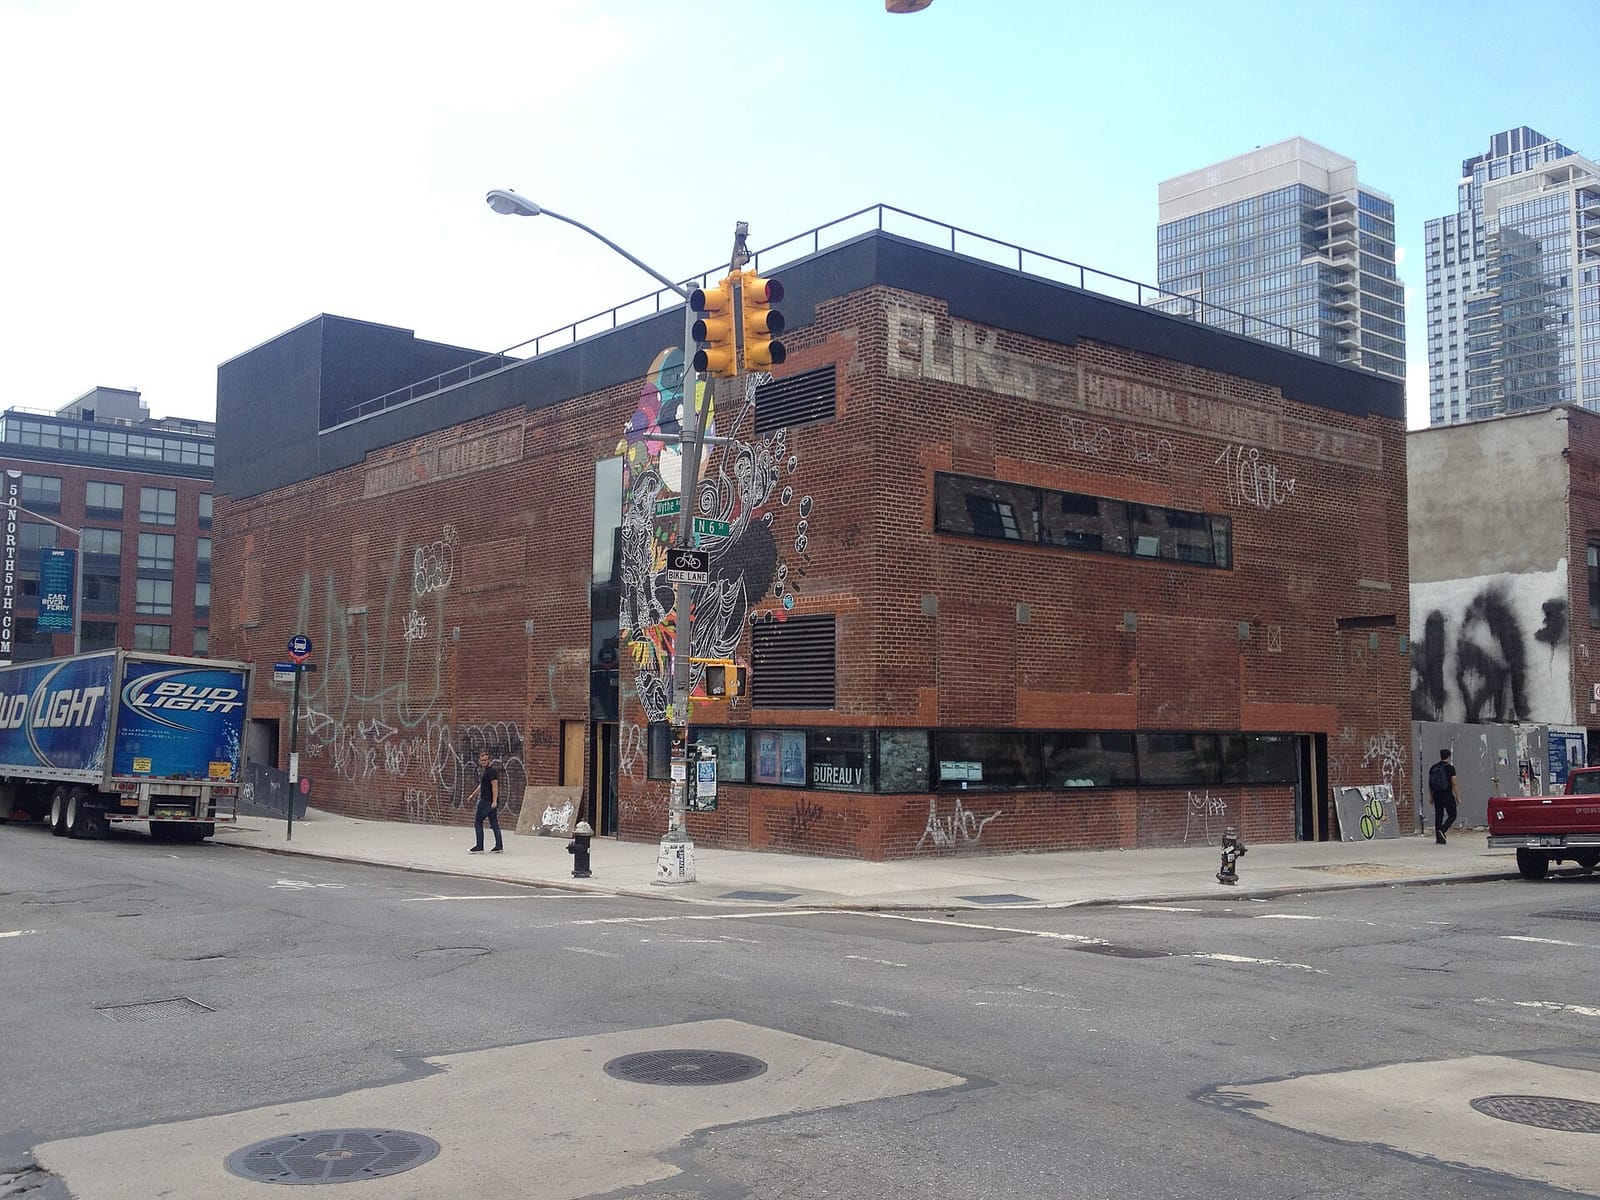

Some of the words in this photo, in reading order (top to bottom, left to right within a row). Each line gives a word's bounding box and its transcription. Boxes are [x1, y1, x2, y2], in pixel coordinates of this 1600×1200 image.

[656, 501, 674, 516] Wythe
[698, 520, 705, 533] N
[709, 521, 715, 534] 6
[668, 571, 685, 580] BIKE
[687, 573, 707, 583] LANE
[46, 604, 70, 612] FERRY
[152, 682, 239, 701] BUD
[0, 691, 29, 729] UD
[32, 686, 106, 728] LIGHT
[132, 693, 243, 713] LIGHT
[813, 766, 852, 784] BUREAU
[855, 768, 862, 785] V
